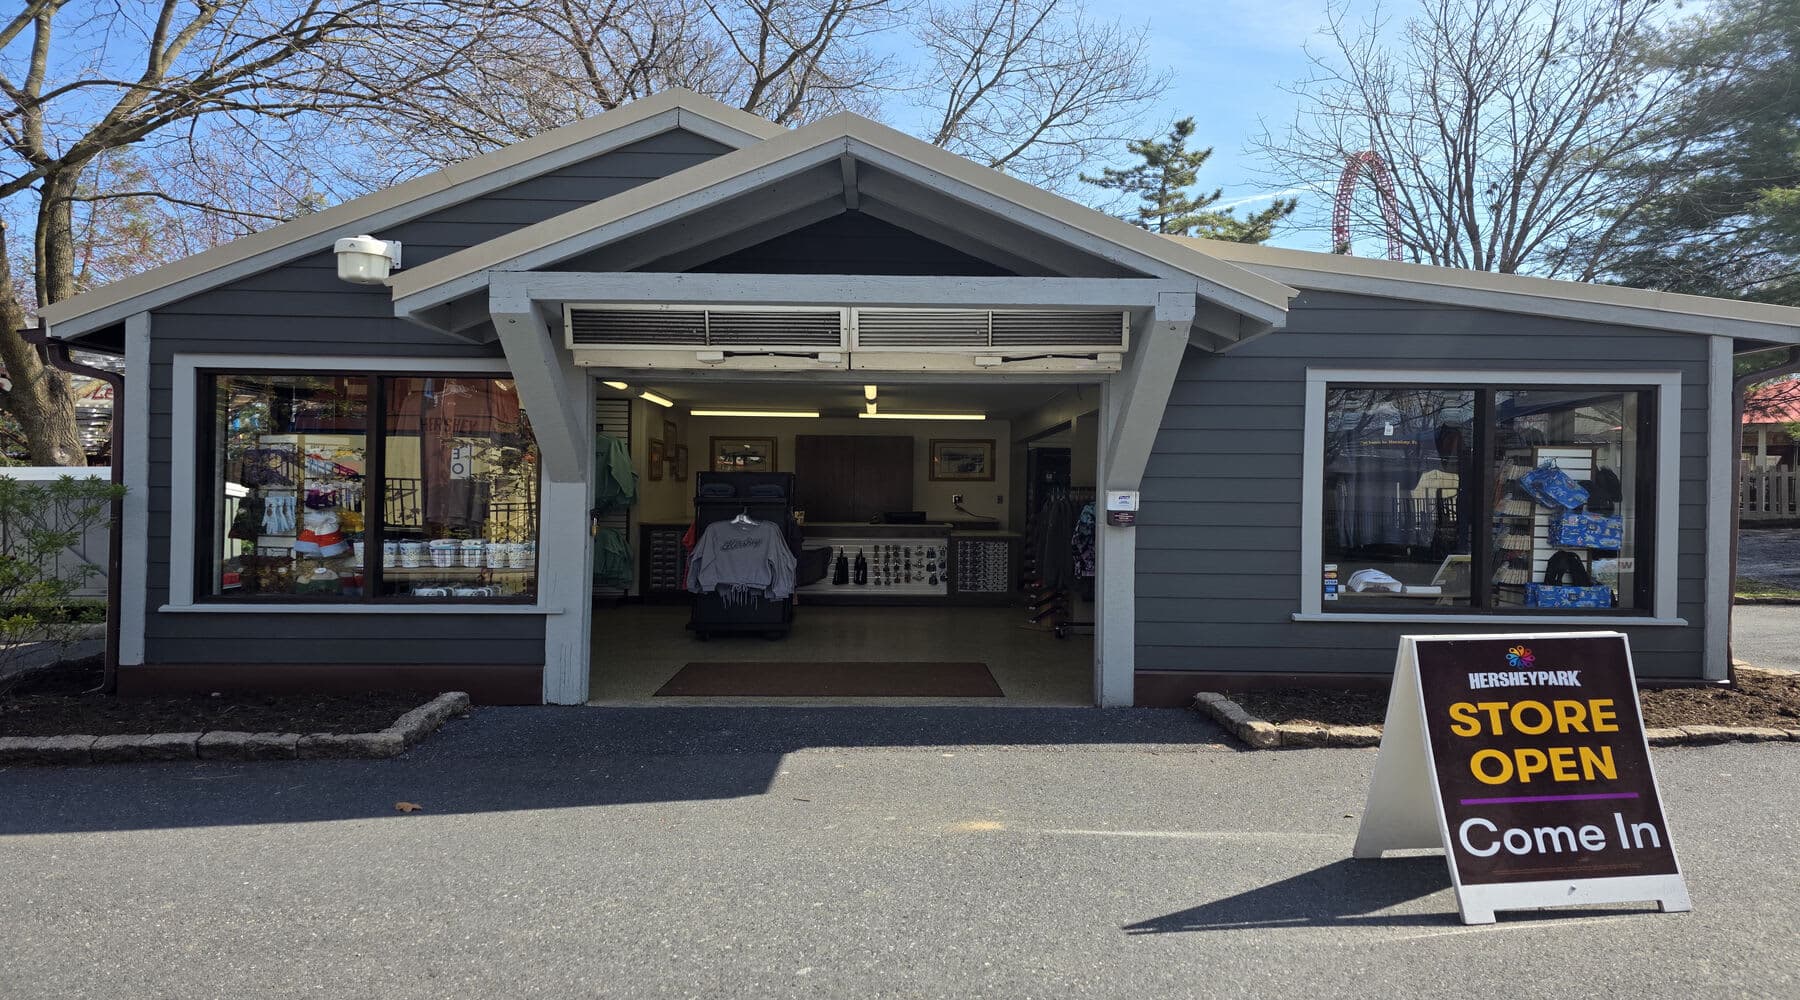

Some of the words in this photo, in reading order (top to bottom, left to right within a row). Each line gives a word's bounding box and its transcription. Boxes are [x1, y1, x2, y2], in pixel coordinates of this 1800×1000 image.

[1468, 670, 1581, 689] HERSHEYPARK
[1449, 699, 1619, 737] STORE
[1470, 746, 1617, 784] OPEN
[1459, 818, 1606, 857] Come
[1612, 812, 1661, 849] In
